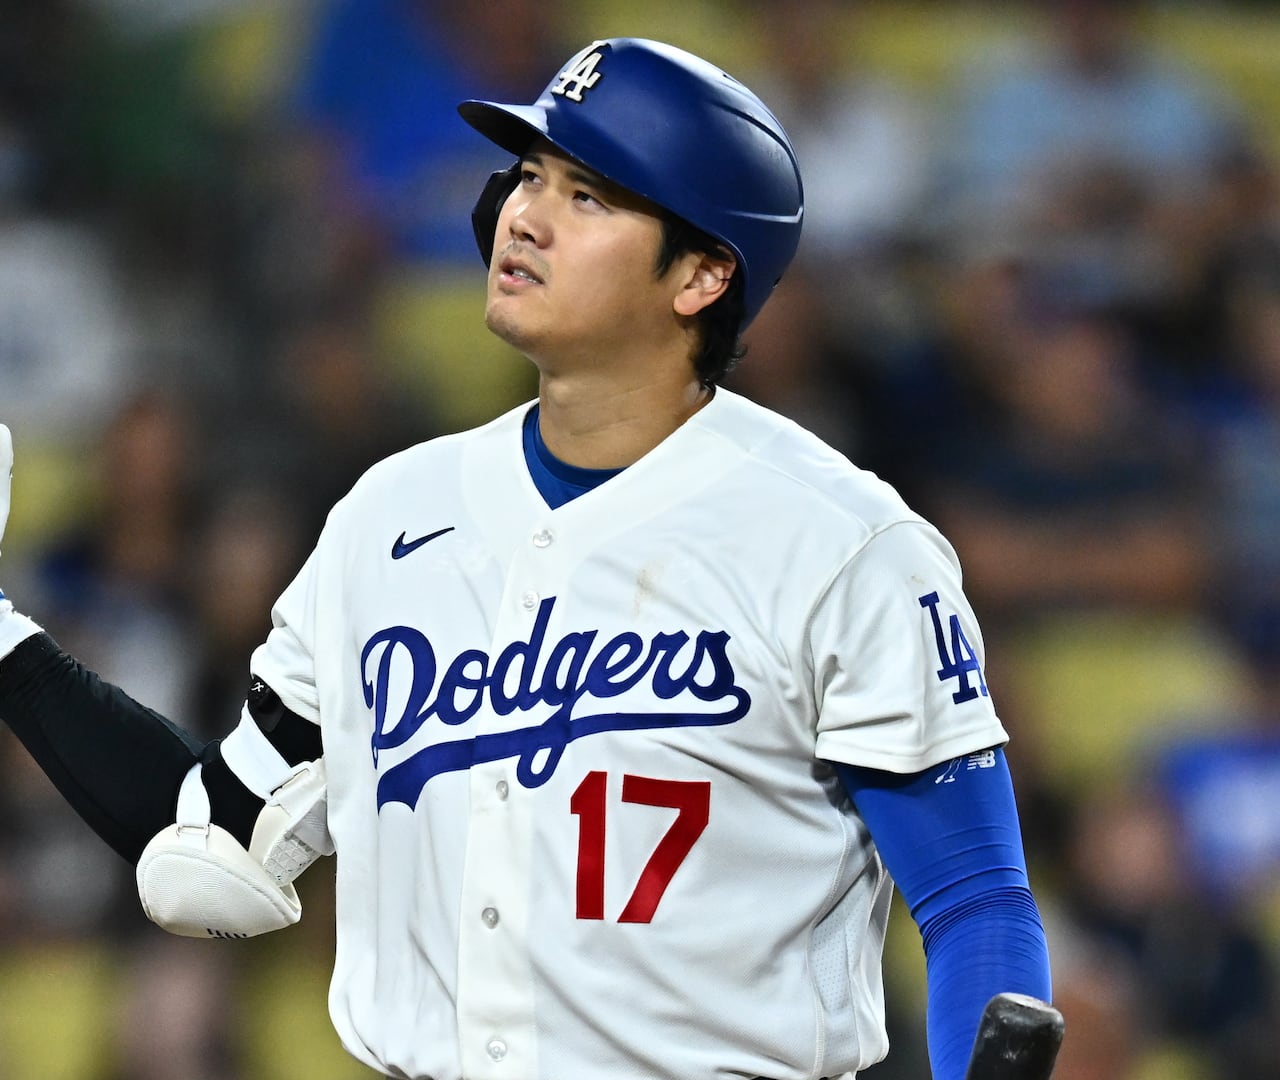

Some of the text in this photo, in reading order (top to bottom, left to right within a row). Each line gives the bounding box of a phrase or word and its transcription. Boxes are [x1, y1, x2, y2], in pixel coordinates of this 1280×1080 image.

[361, 596, 751, 800] Dodgers
[918, 590, 989, 705] LA
[570, 770, 711, 924] 17
